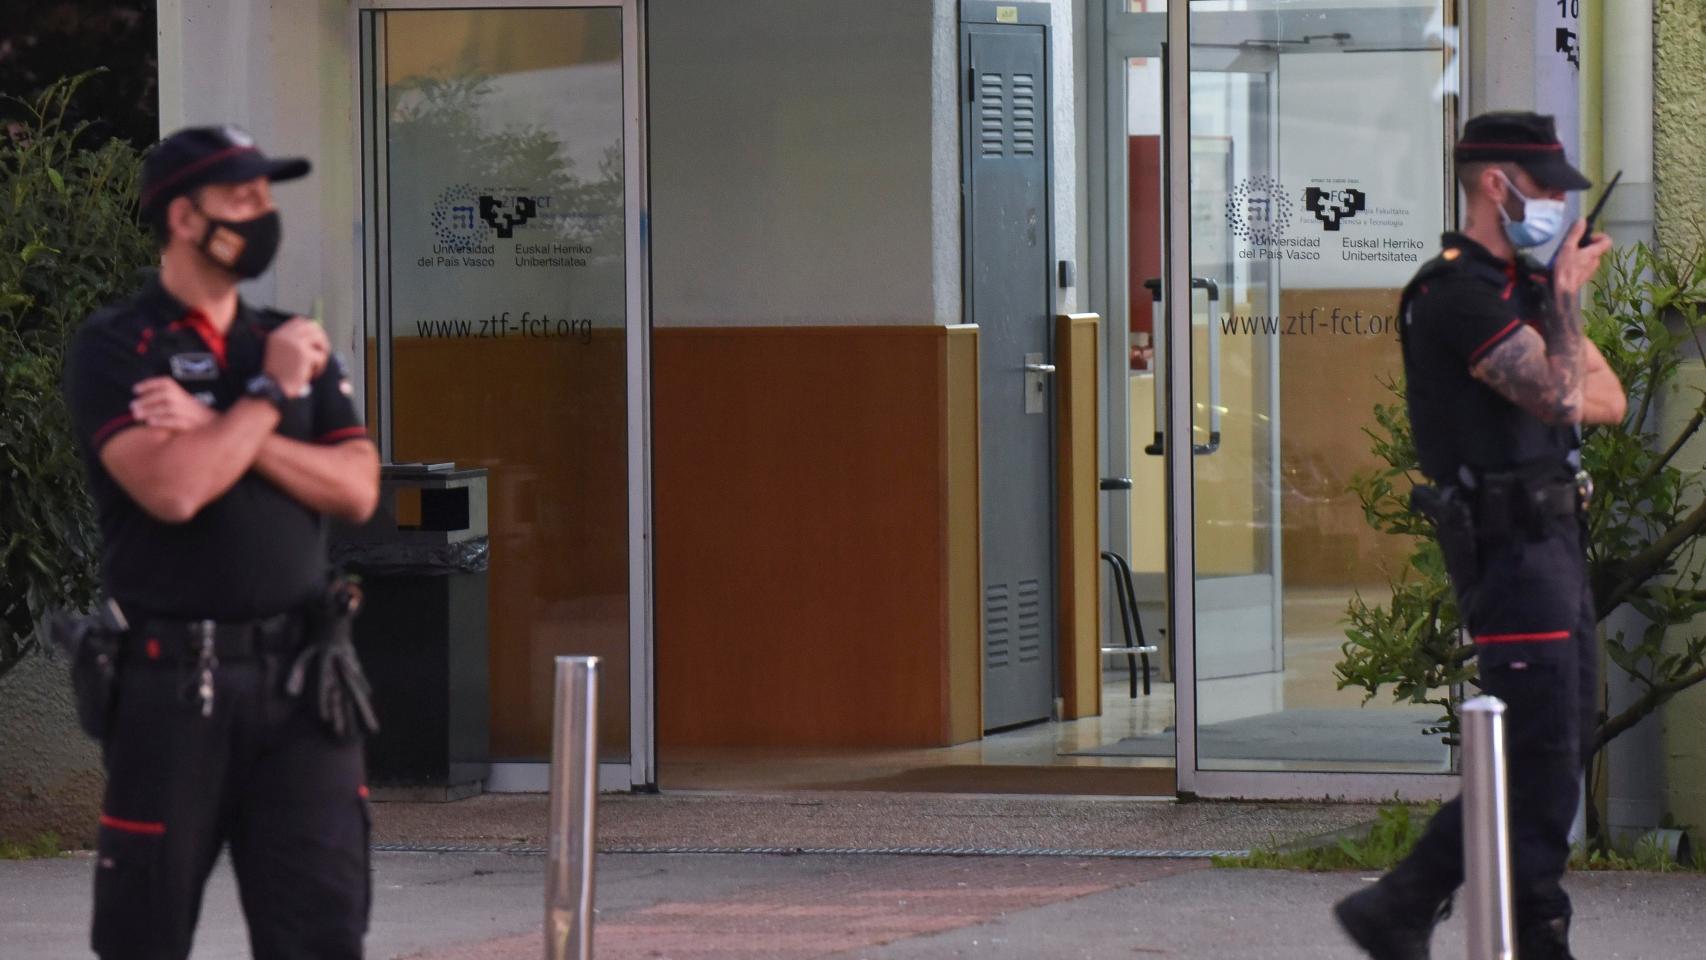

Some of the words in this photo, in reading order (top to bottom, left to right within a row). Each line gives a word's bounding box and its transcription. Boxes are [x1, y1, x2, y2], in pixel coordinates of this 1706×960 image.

[1255, 235, 1321, 248] Universidad
[1342, 236, 1379, 249] Euskal
[1382, 237, 1424, 249] Herriko
[433, 243, 495, 255] Universidad
[515, 243, 550, 255] Euskal
[553, 243, 592, 255] Herriko
[1239, 248, 1256, 260] del
[1286, 249, 1320, 261] Vasco
[417, 256, 434, 268] del
[462, 256, 495, 268] Vasco
[515, 256, 587, 268] Unibertsitatea
[1342, 250, 1418, 263] Unibertsitatea
[417, 311, 592, 346] www.ztf-fct.org
